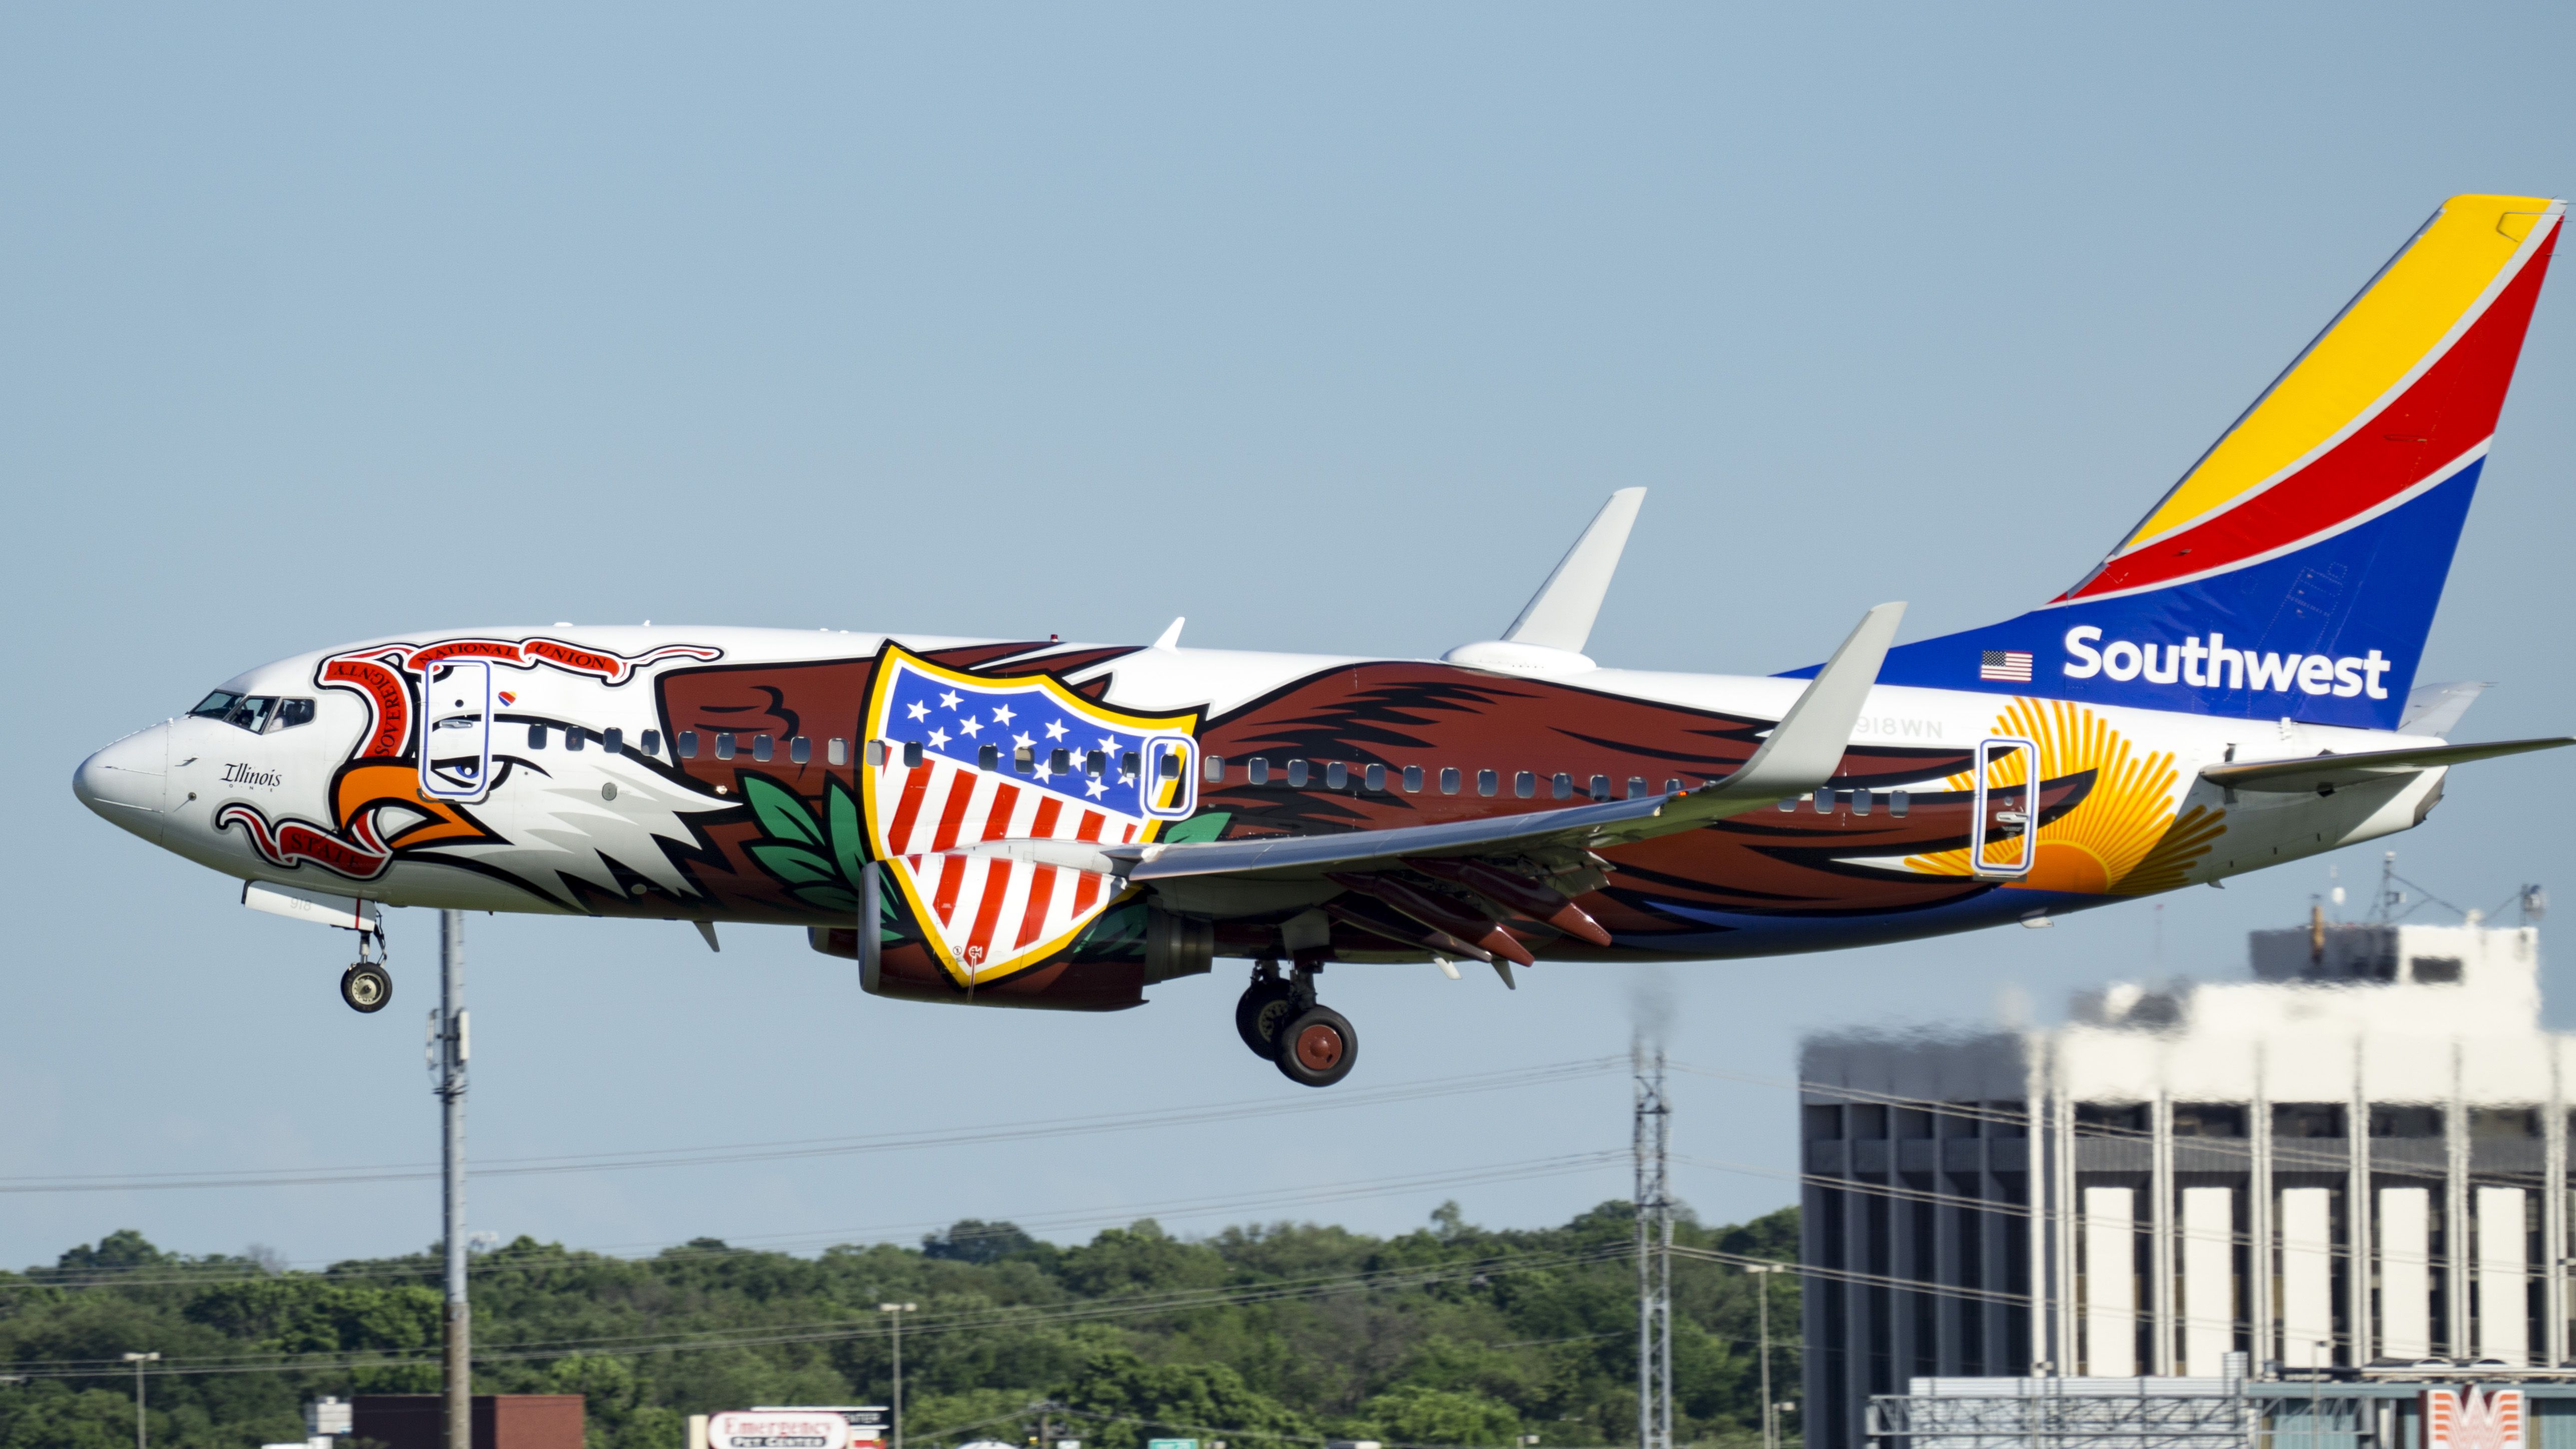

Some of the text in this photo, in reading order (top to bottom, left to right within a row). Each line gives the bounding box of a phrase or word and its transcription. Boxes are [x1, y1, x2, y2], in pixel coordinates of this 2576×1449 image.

[2064, 625, 2391, 699] Southwest
[334, 643, 607, 757] SOVEREIGNTY NATIONAL UNION
[219, 763, 283, 787] Illinois
[290, 832, 363, 869] STATE
[290, 898, 312, 911] 918
[724, 1417, 832, 1437] Emergency
